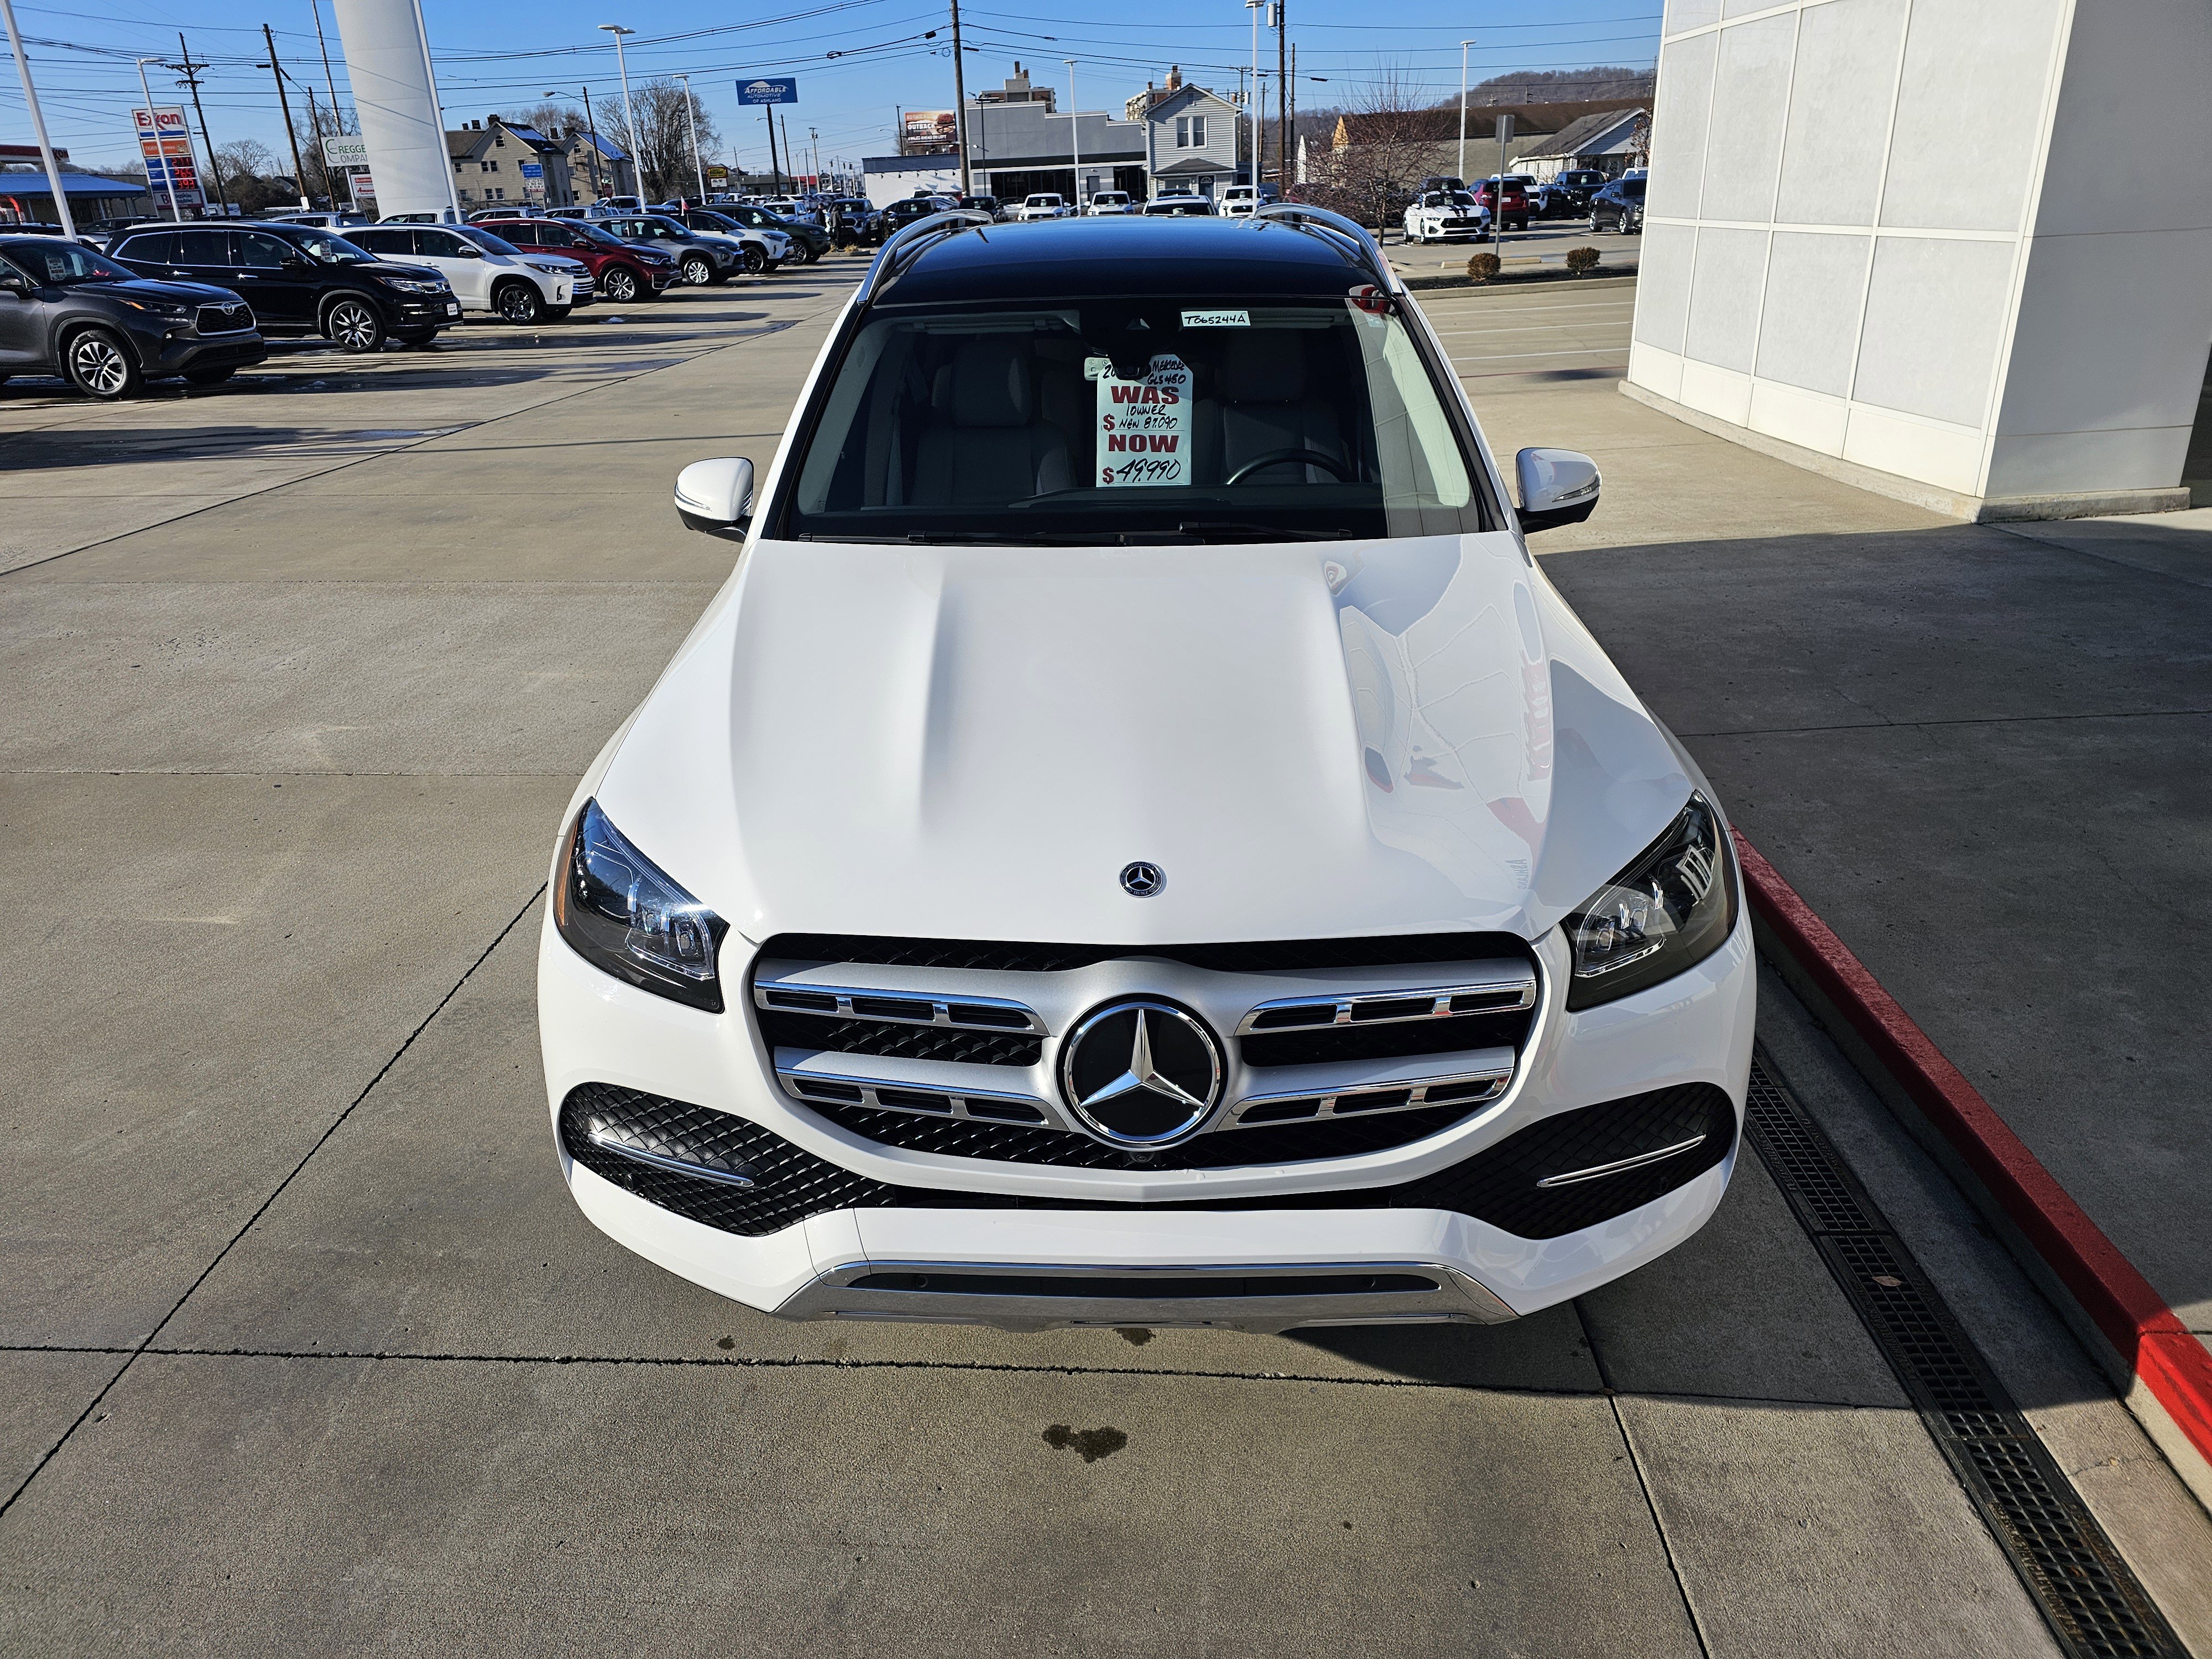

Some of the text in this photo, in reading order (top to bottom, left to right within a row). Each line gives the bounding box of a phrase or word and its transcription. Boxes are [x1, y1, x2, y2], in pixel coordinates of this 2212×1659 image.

[1184, 314, 1246, 325] T065244A
[1110, 385, 1180, 405] WAS
[1103, 414, 1115, 432] $
[1119, 418, 1140, 430] NEW
[1108, 434, 1180, 453] NOW
[1102, 466, 1115, 485] $
